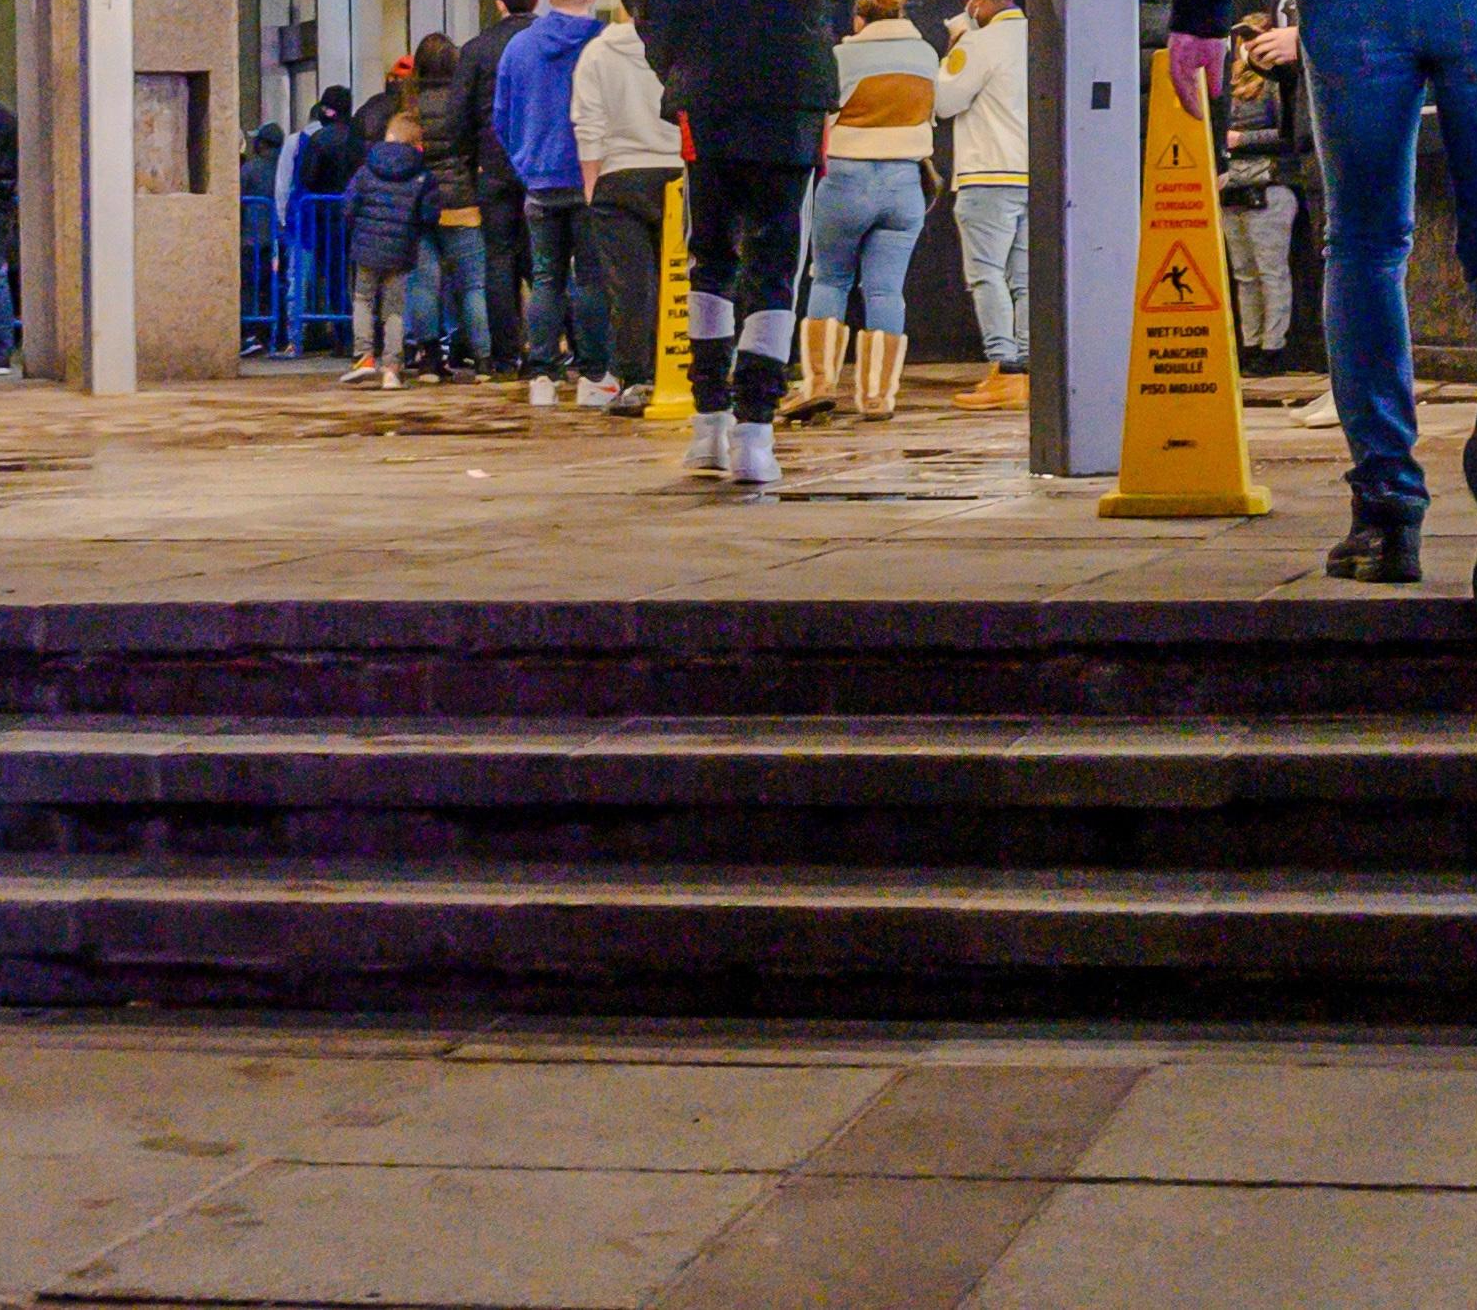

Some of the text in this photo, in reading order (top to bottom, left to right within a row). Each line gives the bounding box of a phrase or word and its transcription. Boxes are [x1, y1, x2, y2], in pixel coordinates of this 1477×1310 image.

[1155, 183, 1202, 194] CAUTION
[1146, 326, 1210, 338] WET FLOOR
[1148, 347, 1209, 359] PLANCHER
[1140, 383, 1167, 395] PISO
